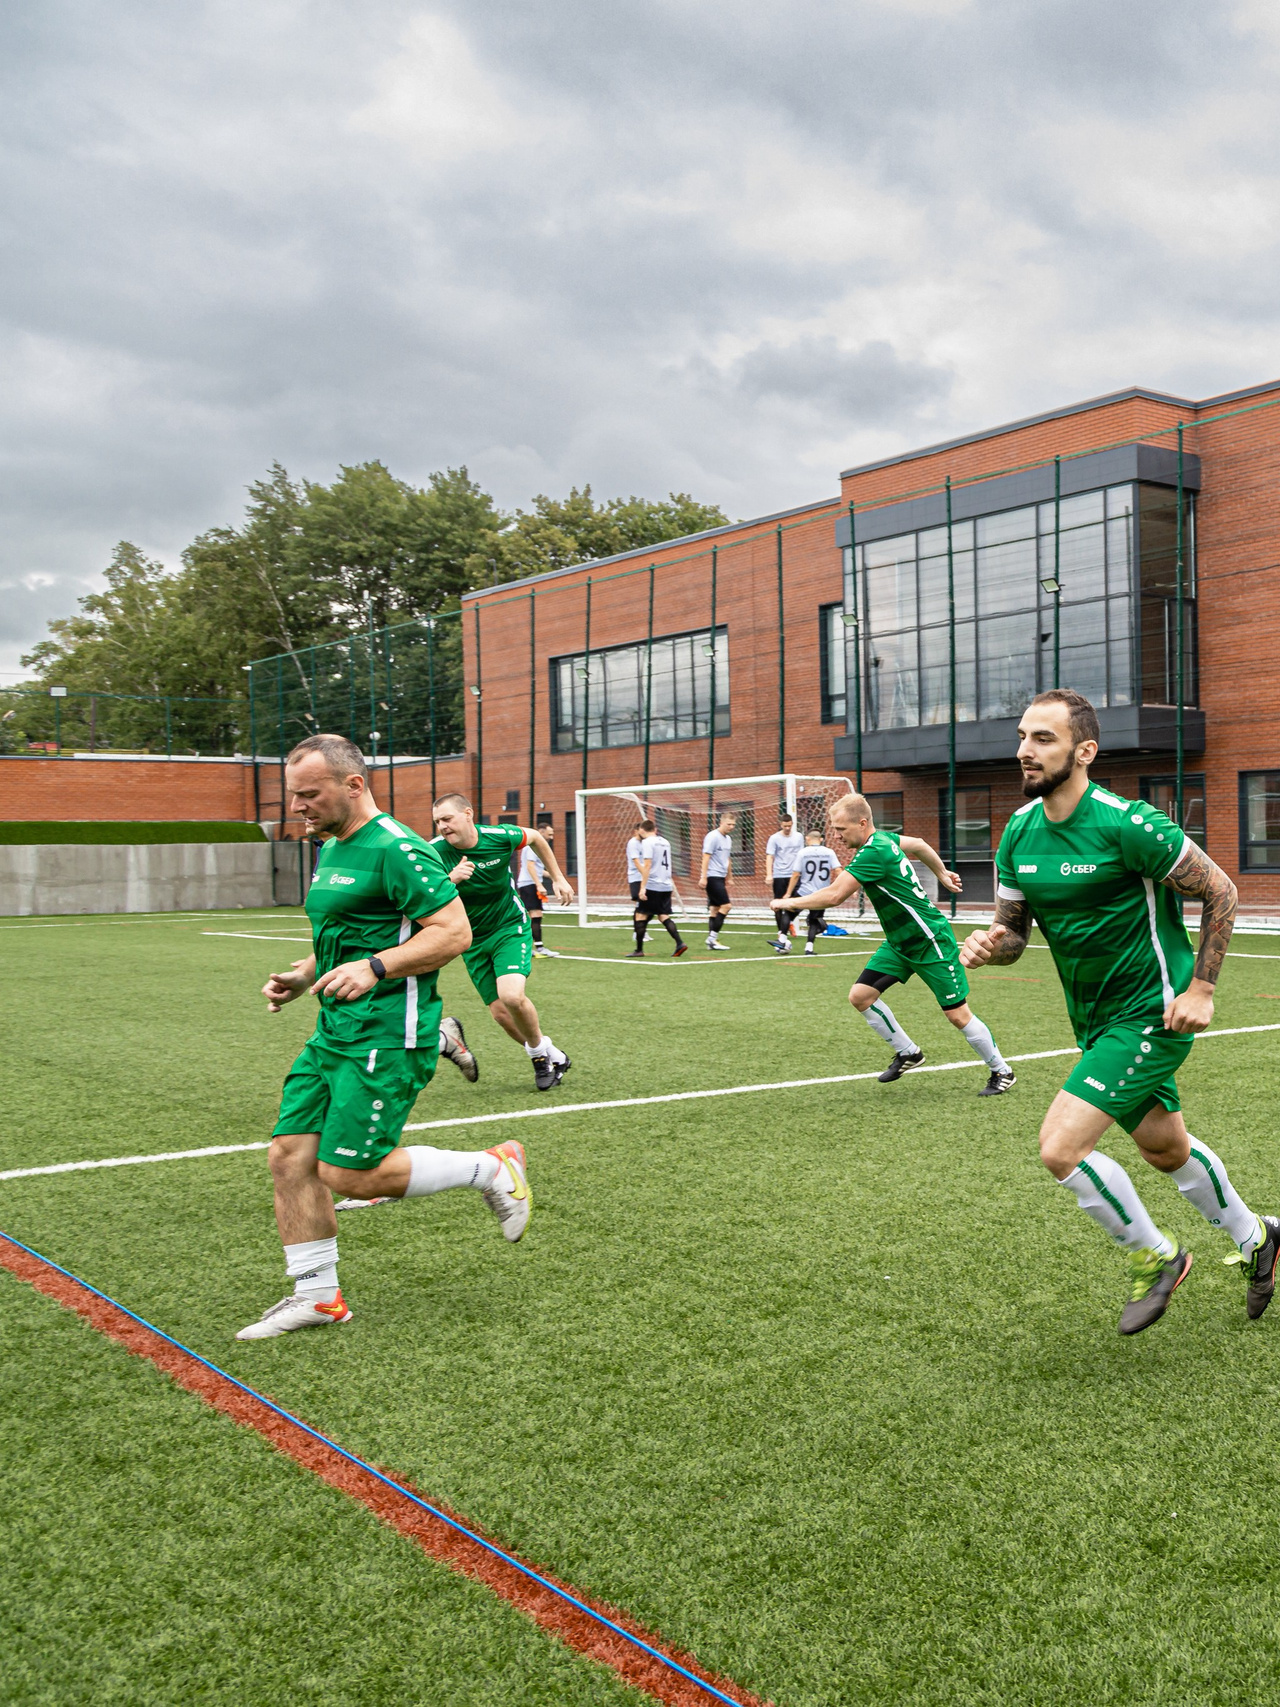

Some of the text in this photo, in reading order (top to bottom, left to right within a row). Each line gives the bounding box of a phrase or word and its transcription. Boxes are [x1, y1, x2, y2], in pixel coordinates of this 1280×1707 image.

[804, 860, 830, 882] 95
[1071, 864, 1097, 874] СБЕР
[1083, 1076, 1106, 1092] JAKO
